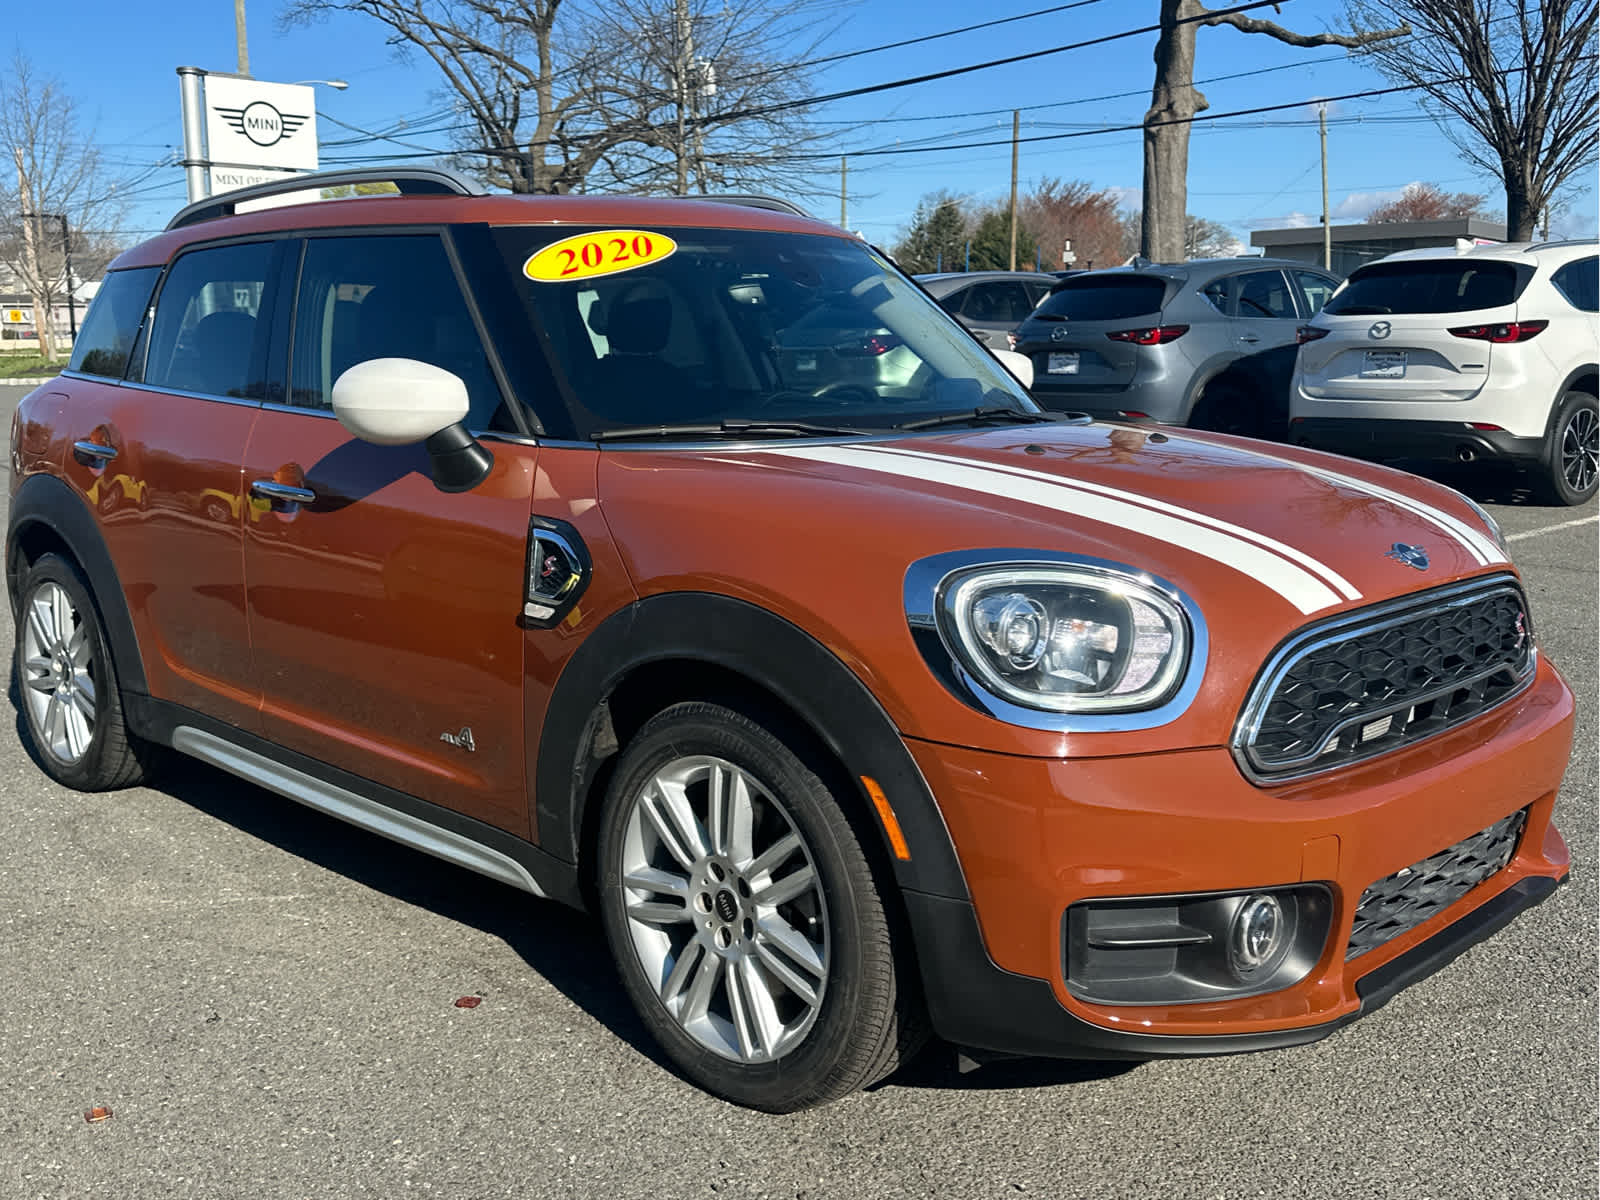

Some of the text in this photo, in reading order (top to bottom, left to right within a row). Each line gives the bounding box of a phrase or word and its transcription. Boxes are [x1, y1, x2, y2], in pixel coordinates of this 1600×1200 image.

[247, 117, 279, 131] MINI
[215, 174, 244, 185] MINI
[556, 235, 653, 276] 2020
[719, 893, 734, 919] MINI
